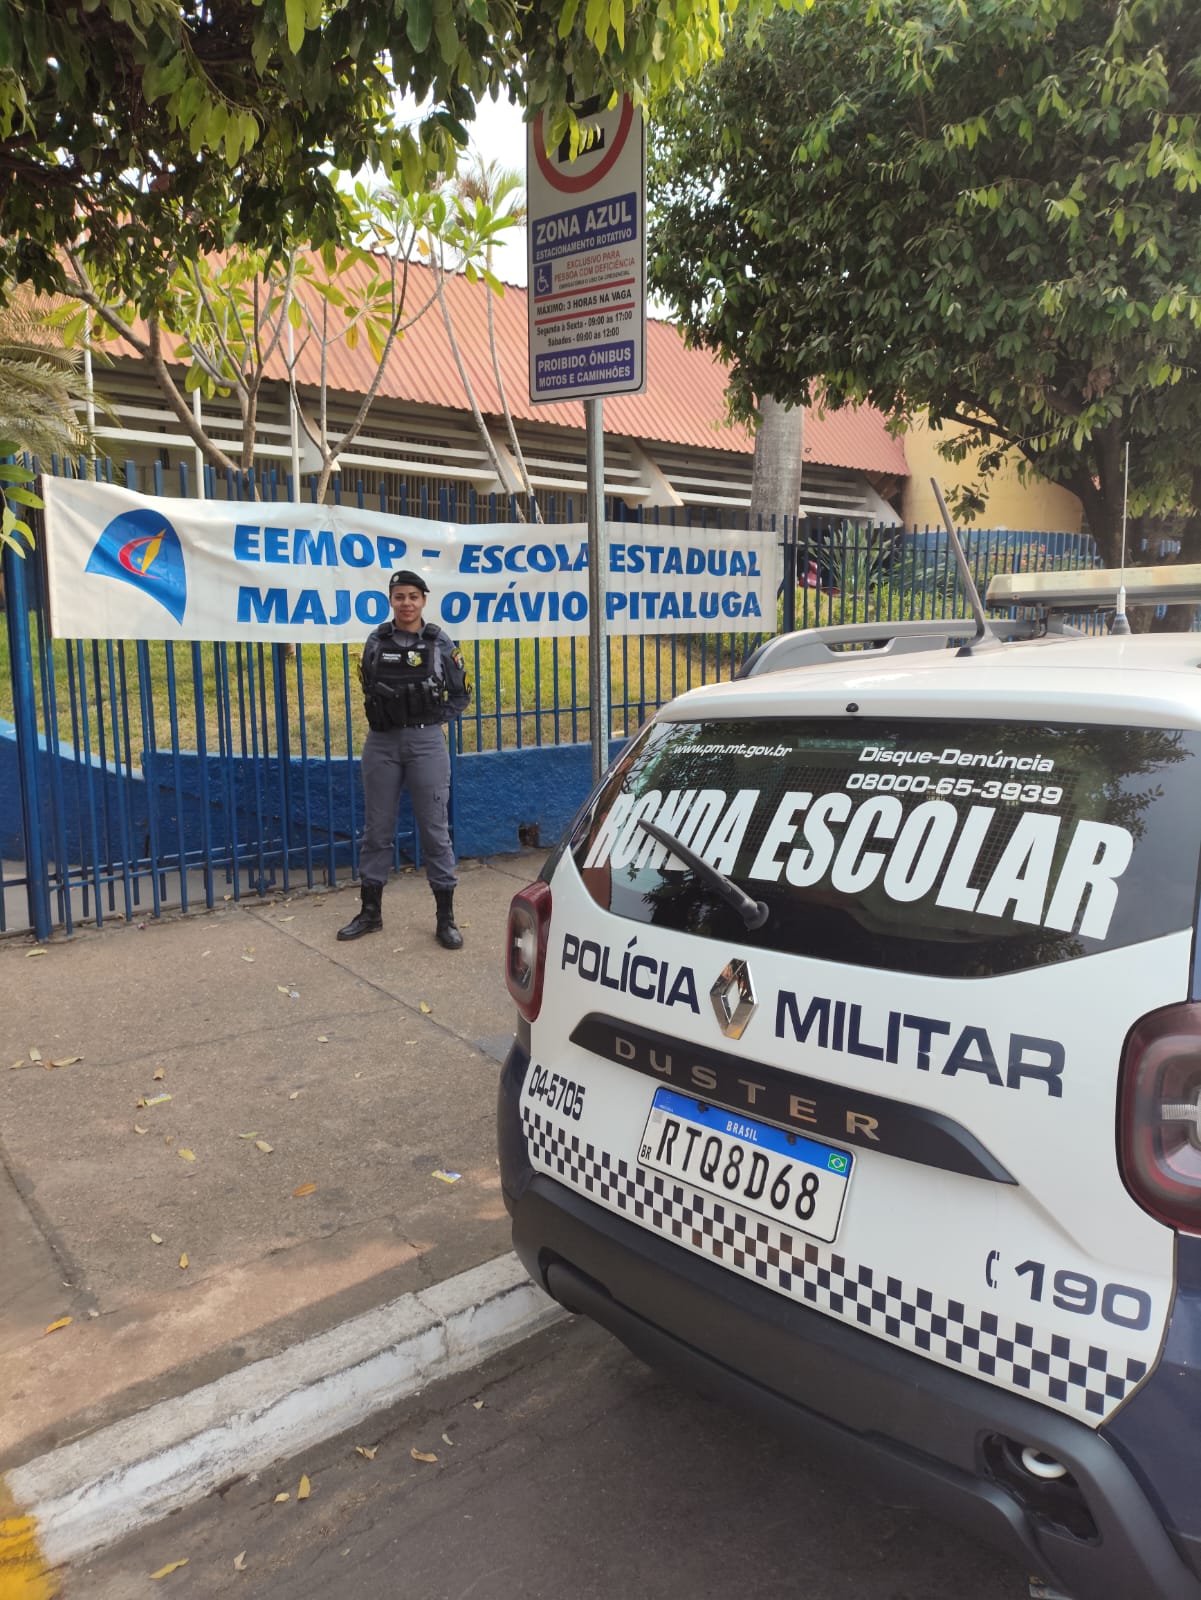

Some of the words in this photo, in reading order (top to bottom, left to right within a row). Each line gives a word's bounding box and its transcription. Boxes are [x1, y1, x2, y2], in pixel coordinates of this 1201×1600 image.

[536, 214, 581, 245] ZONA
[585, 201, 632, 232] AZUL
[536, 237, 595, 261] ESTACIONAMENTO
[597, 228, 632, 245] ROTATIVO
[567, 255, 601, 269] EXCLUSIVO
[603, 250, 620, 261] PARA
[554, 270, 578, 282] PESSOA
[579, 266, 593, 277] COM
[595, 256, 635, 273] DEFICIÊNCIA
[537, 302, 566, 316] MÁXIMO:
[567, 302, 571, 310] 3
[573, 295, 597, 309] HORAS
[600, 293, 610, 303] NA
[611, 289, 632, 301] VAGA
[536, 322, 560, 336] Segunda
[566, 320, 584, 332] Sexta
[588, 314, 604, 327] 09:00
[615, 310, 632, 322] 17:00
[576, 330, 592, 343] 09:00
[603, 327, 620, 337] 12:00
[538, 354, 587, 372] PROIBIDO
[589, 347, 631, 365] ÔNIBUS
[539, 374, 567, 388] MOTOS
[569, 375, 575, 383] E
[577, 366, 631, 383] CAMINHÕES
[234, 524, 407, 569] EEMOP
[421, 549, 441, 558] -
[459, 542, 590, 574] ESCOLA
[609, 543, 761, 577] ESTADUAL
[236, 585, 391, 625] MAJO
[440, 581, 589, 624] OTÁVIO
[605, 591, 762, 620] PITALUGA
[673, 742, 792, 758] www.pm.mt.gov.br
[858, 746, 1054, 772] Disque-Denúncia
[846, 772, 1063, 805] 08000-65-3939
[582, 788, 761, 877] RONDA
[748, 791, 1135, 941] ESCOLAR
[561, 933, 700, 1015] POLÍCIA
[774, 989, 1066, 1098] MILITAR
[528, 1064, 586, 1121] 04-5705
[615, 1036, 880, 1142] DUSTER
[726, 1120, 758, 1141] BRASIL
[641, 1145, 652, 1160] BR
[655, 1118, 820, 1221] RTQ8D68
[1014, 1259, 1152, 1331] 190
